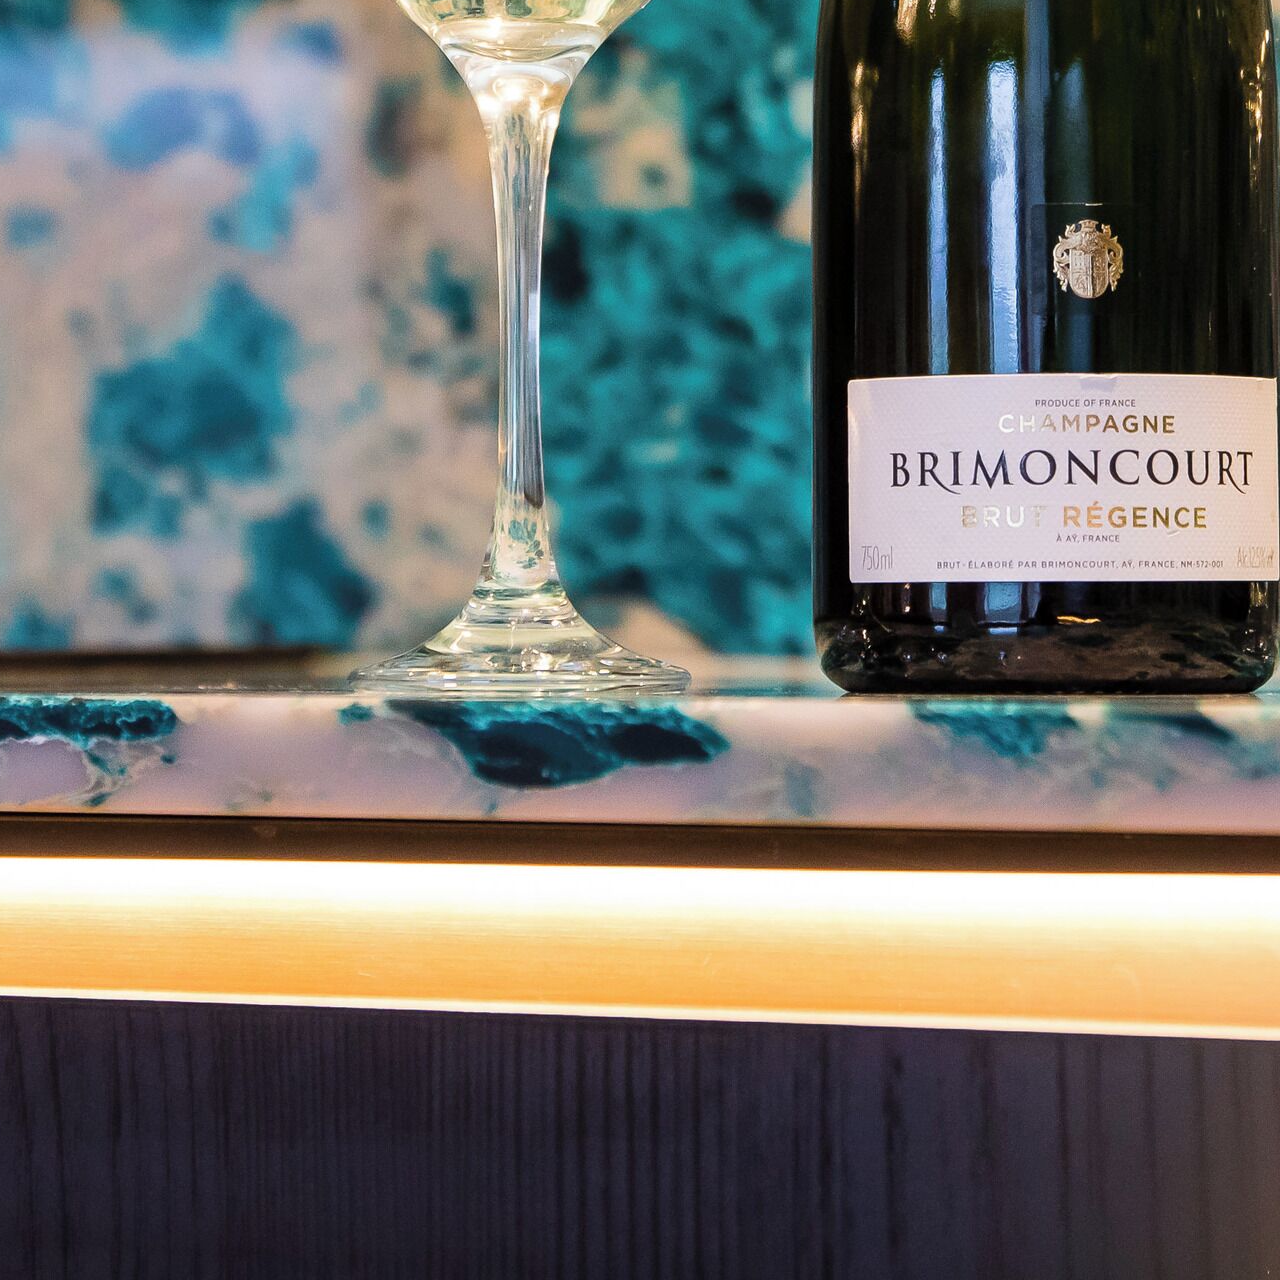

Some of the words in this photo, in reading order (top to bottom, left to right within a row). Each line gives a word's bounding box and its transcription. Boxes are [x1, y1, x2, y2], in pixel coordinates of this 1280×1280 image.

[1035, 399, 1080, 408] PRODUCE
[1083, 399, 1097, 408] OF
[1099, 399, 1136, 408] FRANCE
[998, 414, 1175, 434] CHAMPAGNE
[890, 448, 1253, 494] BRIMONCOURT
[960, 505, 1048, 529] BRUT
[1063, 500, 1207, 529] RÉGENCE
[1082, 534, 1120, 543] FRANCE
[861, 545, 893, 571] 750ml
[936, 560, 961, 570] BRUT
[968, 559, 1014, 570] ÉLABORÉ
[1017, 560, 1037, 569] PAR
